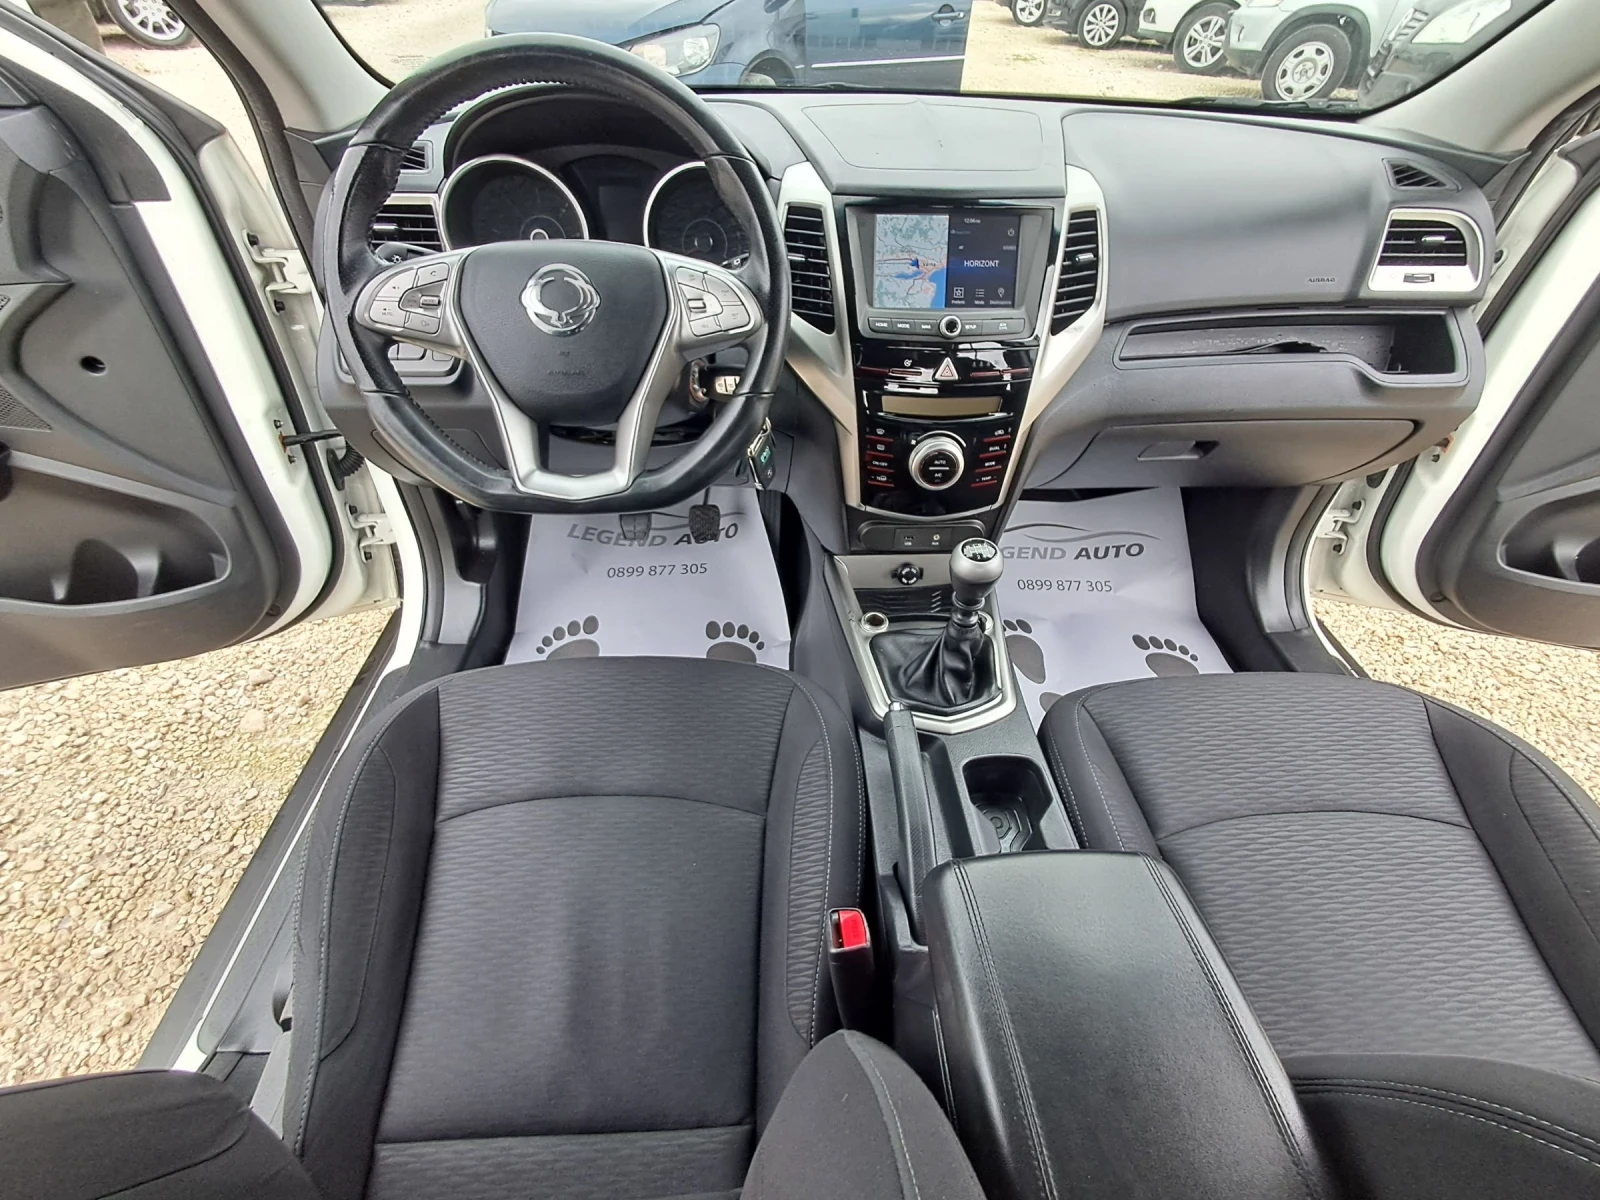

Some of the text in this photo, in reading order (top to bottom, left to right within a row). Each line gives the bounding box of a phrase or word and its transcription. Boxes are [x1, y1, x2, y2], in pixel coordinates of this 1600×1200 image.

[963, 259, 1000, 268] HORIZONT
[673, 522, 739, 546] AO
[1073, 543, 1145, 560] AUTO
[607, 562, 708, 578] 0899 877 305
[1017, 579, 1113, 593] 0899 877 305
